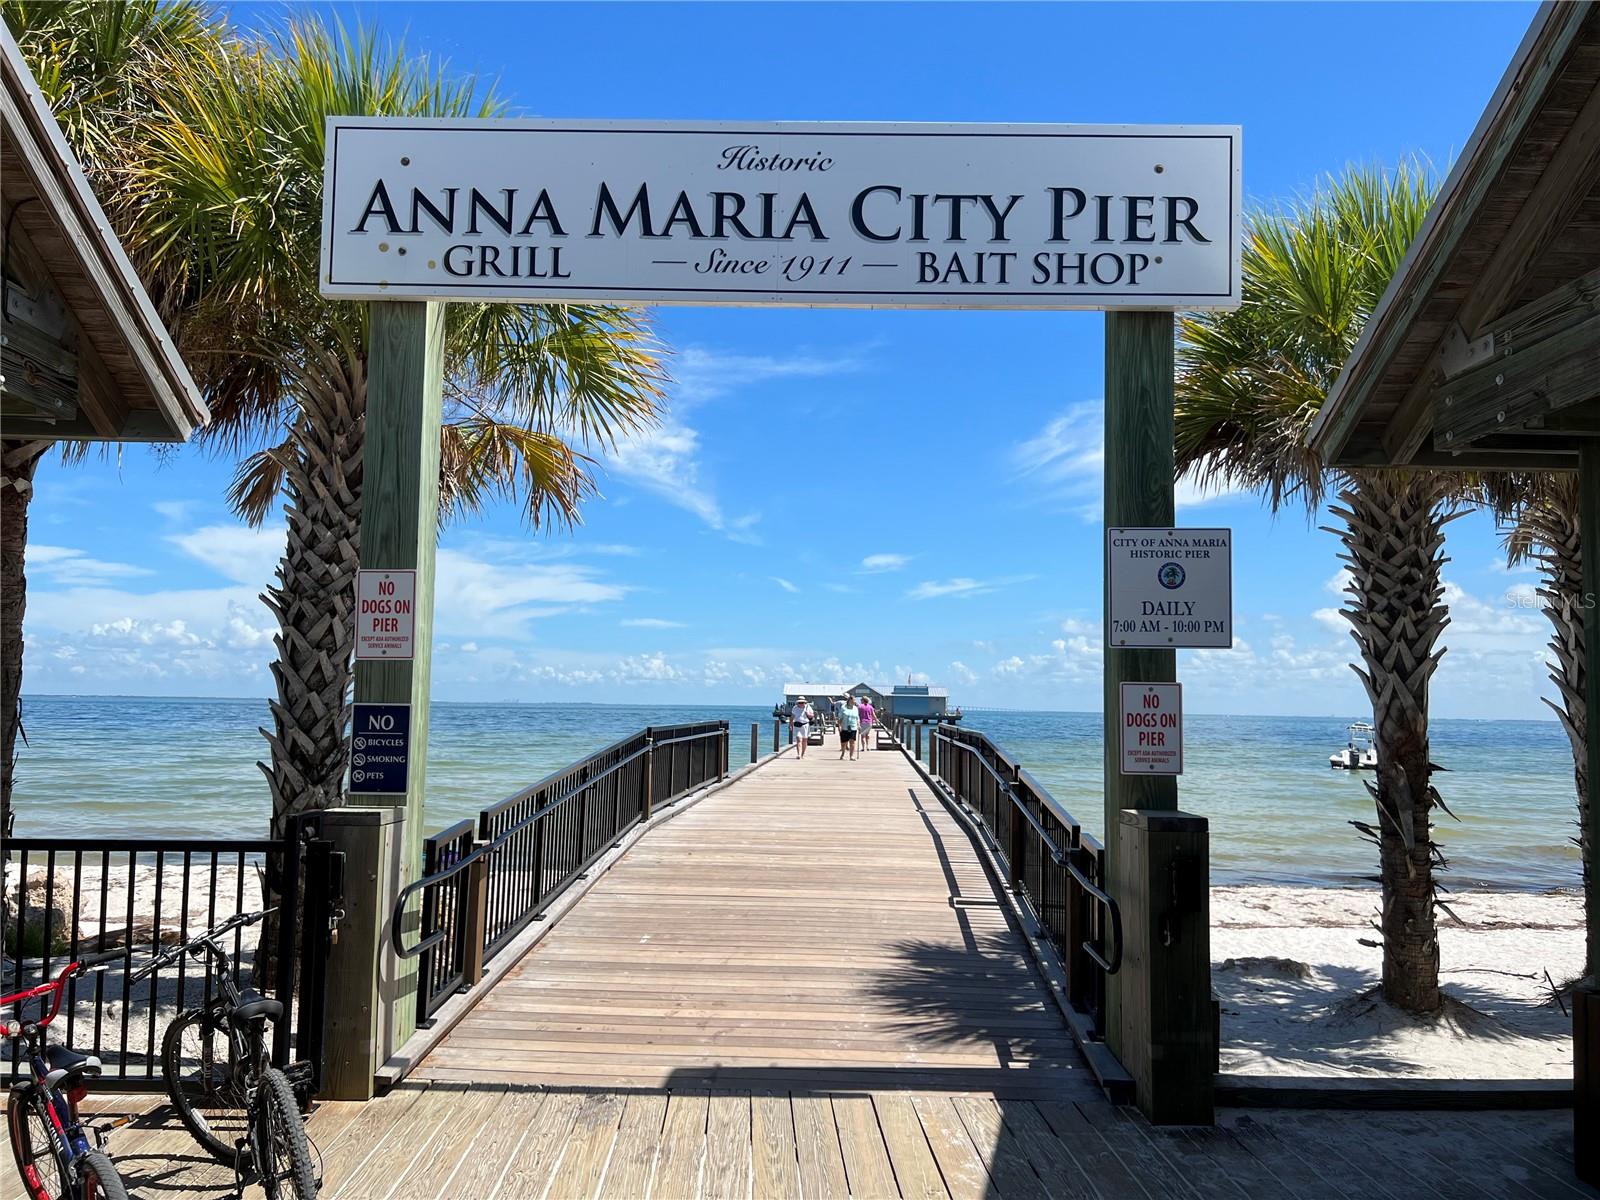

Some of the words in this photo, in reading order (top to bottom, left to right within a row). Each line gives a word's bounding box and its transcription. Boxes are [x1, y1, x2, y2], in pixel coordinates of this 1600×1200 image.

[716, 144, 834, 172] Historic
[442, 244, 572, 279] GRILL
[695, 247, 771, 275] Since
[781, 255, 853, 282] 1911
[914, 251, 1018, 285] BAIT
[1030, 252, 1150, 286] SHOP
[1113, 539, 1138, 547] CITY
[1141, 539, 1156, 547] OF
[1158, 539, 1189, 547] ANNA
[1192, 539, 1227, 547] MARIA
[1130, 550, 1182, 559] HISTORIC
[1185, 550, 1210, 559] PIER
[378, 581, 395, 596] NO
[362, 600, 391, 614] DOGS
[394, 600, 410, 614] ON
[1141, 601, 1196, 616] DAILY
[372, 618, 398, 632] PIER
[1113, 620, 1136, 632] 7:00
[1139, 620, 1160, 632] AM
[1173, 620, 1200, 632] 10:00
[1204, 620, 1225, 632] PM
[1143, 694, 1160, 709] NO
[369, 714, 395, 731] NO
[1127, 713, 1157, 728] DOGS
[1160, 713, 1176, 728] ON
[368, 739, 404, 747] BICYCLES
[1139, 732, 1165, 746] PIER
